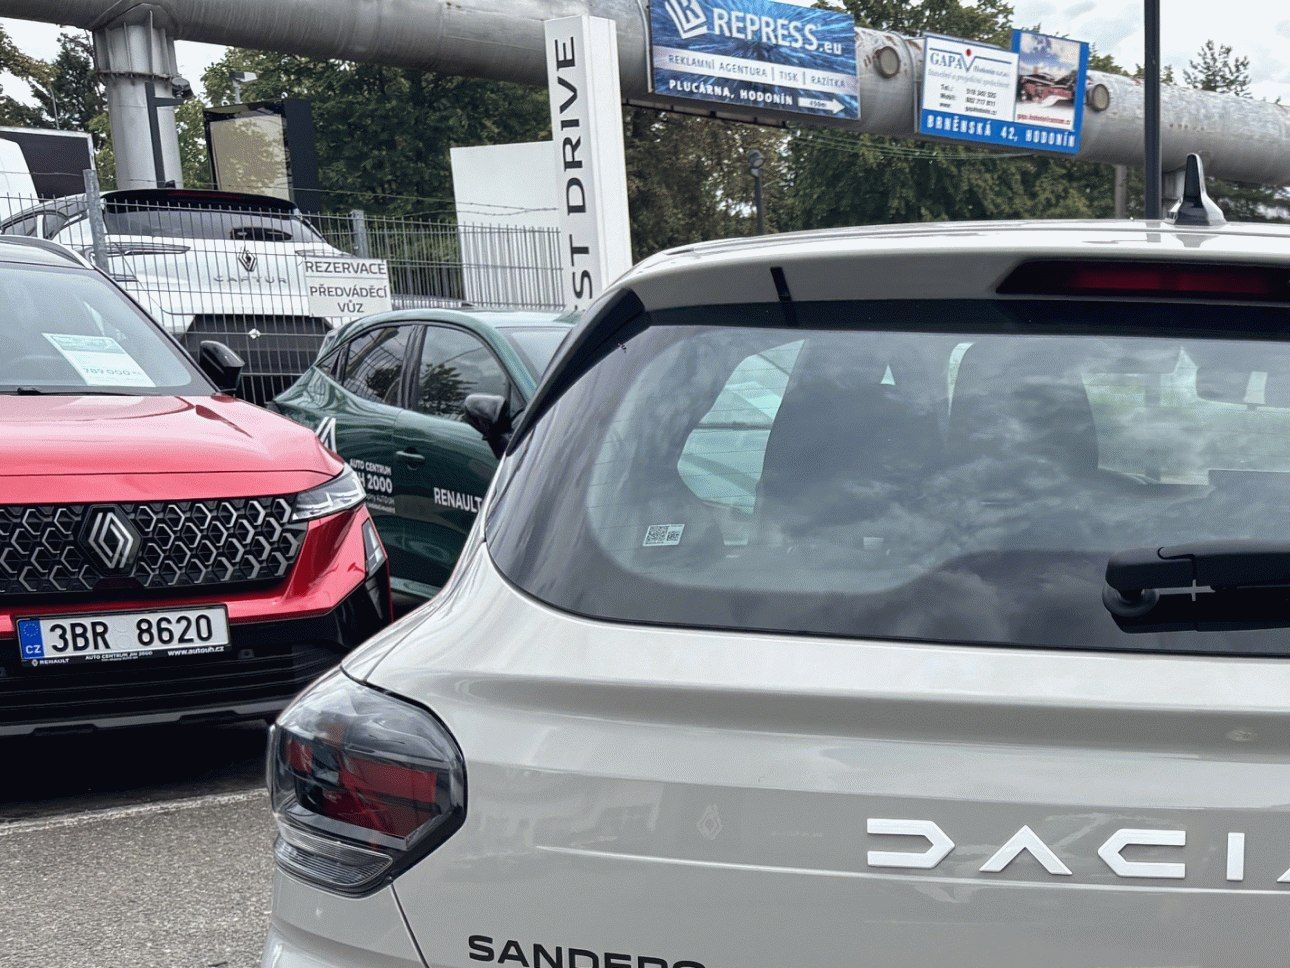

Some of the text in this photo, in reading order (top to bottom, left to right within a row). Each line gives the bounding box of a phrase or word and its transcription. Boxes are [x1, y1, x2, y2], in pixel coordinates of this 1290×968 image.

[712, 8, 842, 54] REPRESS.eu
[668, 54, 715, 70] REKLAMNÍ
[719, 62, 767, 78] AGENTURA
[779, 70, 798, 82] TISK
[740, 89, 793, 106] HODONÍN
[1025, 129, 1076, 148] HODONÍN
[554, 36, 593, 312] ST DRIVE
[305, 261, 387, 275] REZERVACE
[309, 284, 388, 299] PŘEDVÁDĚCÍ
[337, 300, 365, 313] VŮZ
[365, 461, 392, 476] CENTRUM
[366, 474, 393, 494] 2000
[433, 487, 483, 513] RENAULT
[49, 614, 213, 652] 3BR 8620
[25, 645, 42, 654] CZ
